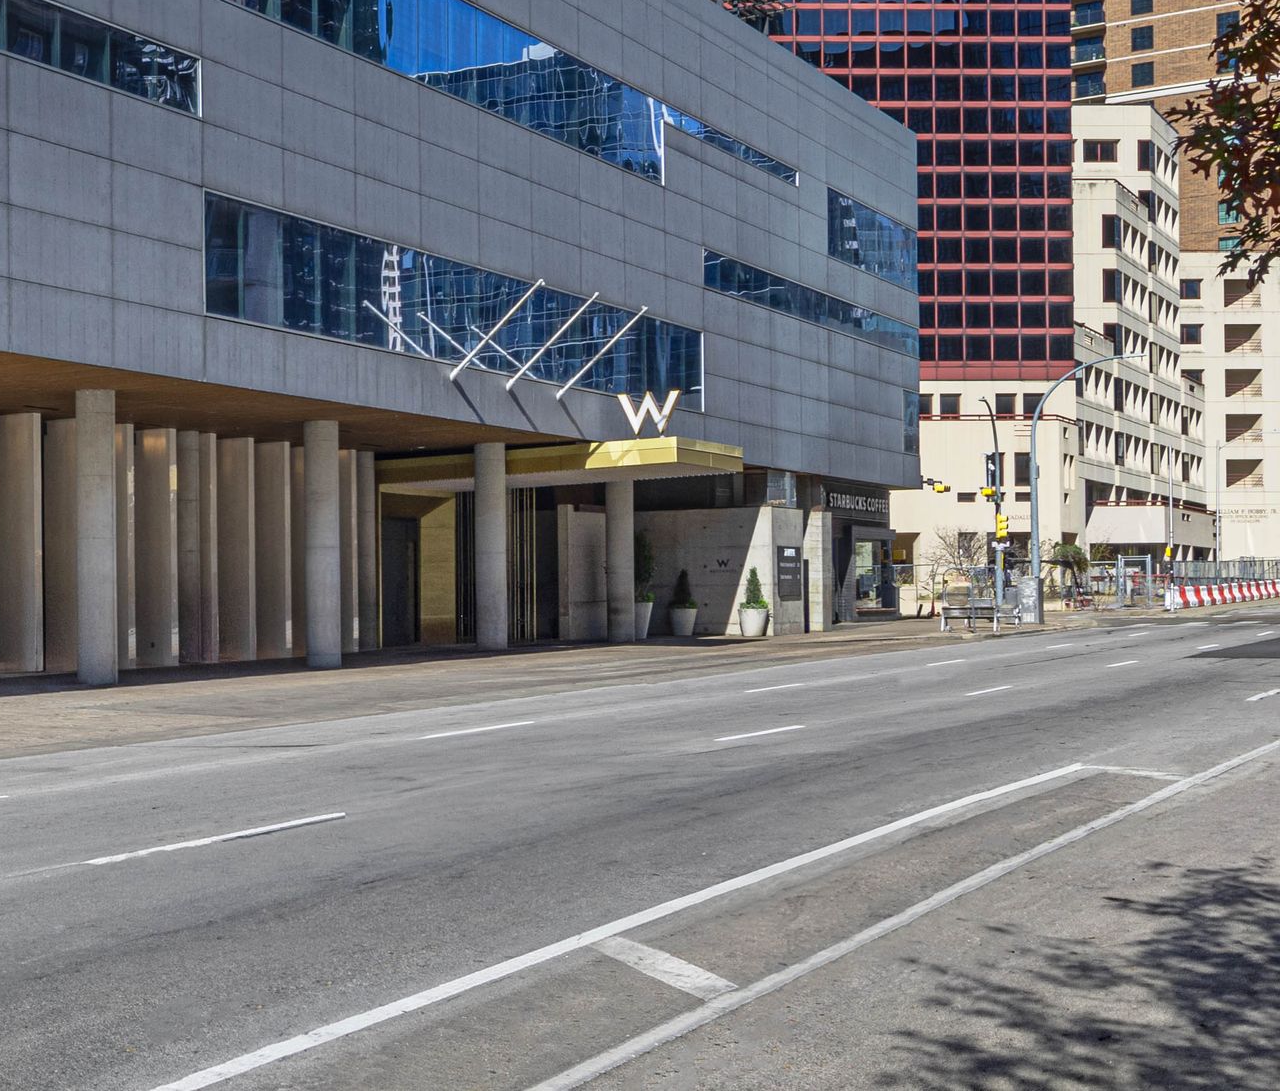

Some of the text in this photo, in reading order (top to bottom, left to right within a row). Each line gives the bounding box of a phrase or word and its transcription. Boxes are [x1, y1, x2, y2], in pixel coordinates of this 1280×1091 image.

[616, 389, 681, 436] W
[829, 492, 889, 513] STARBUCKS COFFEE
[716, 559, 730, 568] W
